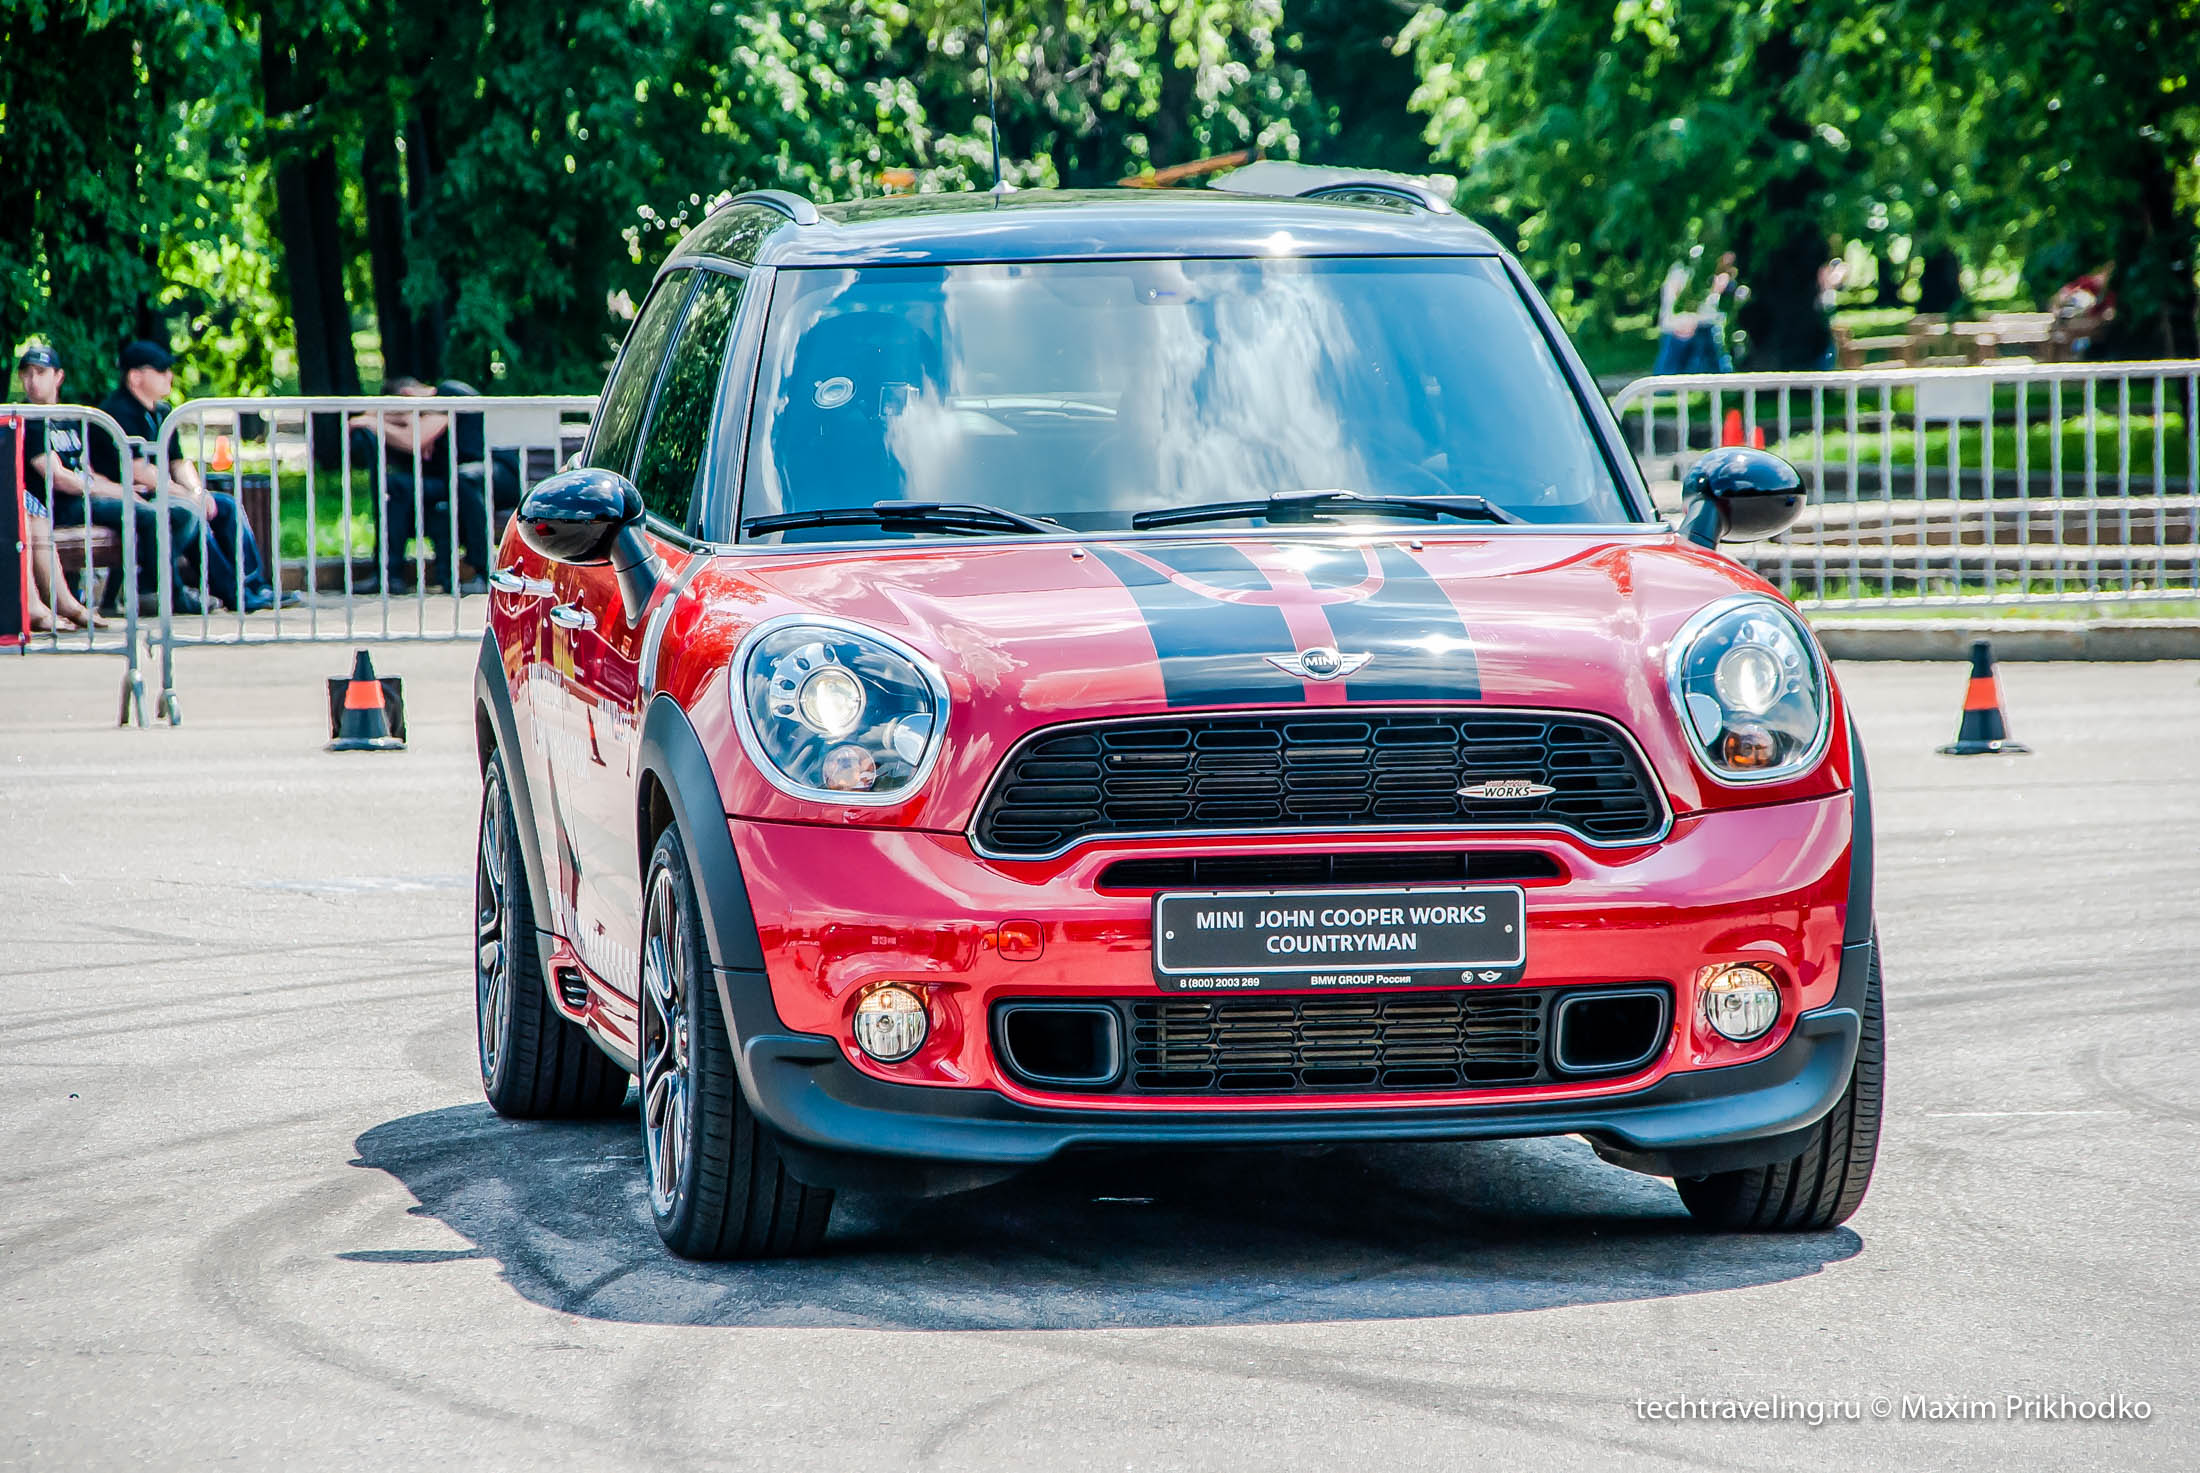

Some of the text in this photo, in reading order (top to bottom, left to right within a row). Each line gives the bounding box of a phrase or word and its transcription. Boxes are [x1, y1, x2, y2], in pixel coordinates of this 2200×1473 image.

[1304, 655, 1339, 667] MINI
[1484, 787, 1530, 798] WORKS
[1196, 905, 1486, 929] MINI JOHN COOPER WORKS
[1266, 932, 1417, 953] COUNTRYMAN
[1180, 976, 1260, 989] 8 (800) 2003 269
[1310, 974, 1412, 986] BMW GROUP Россия
